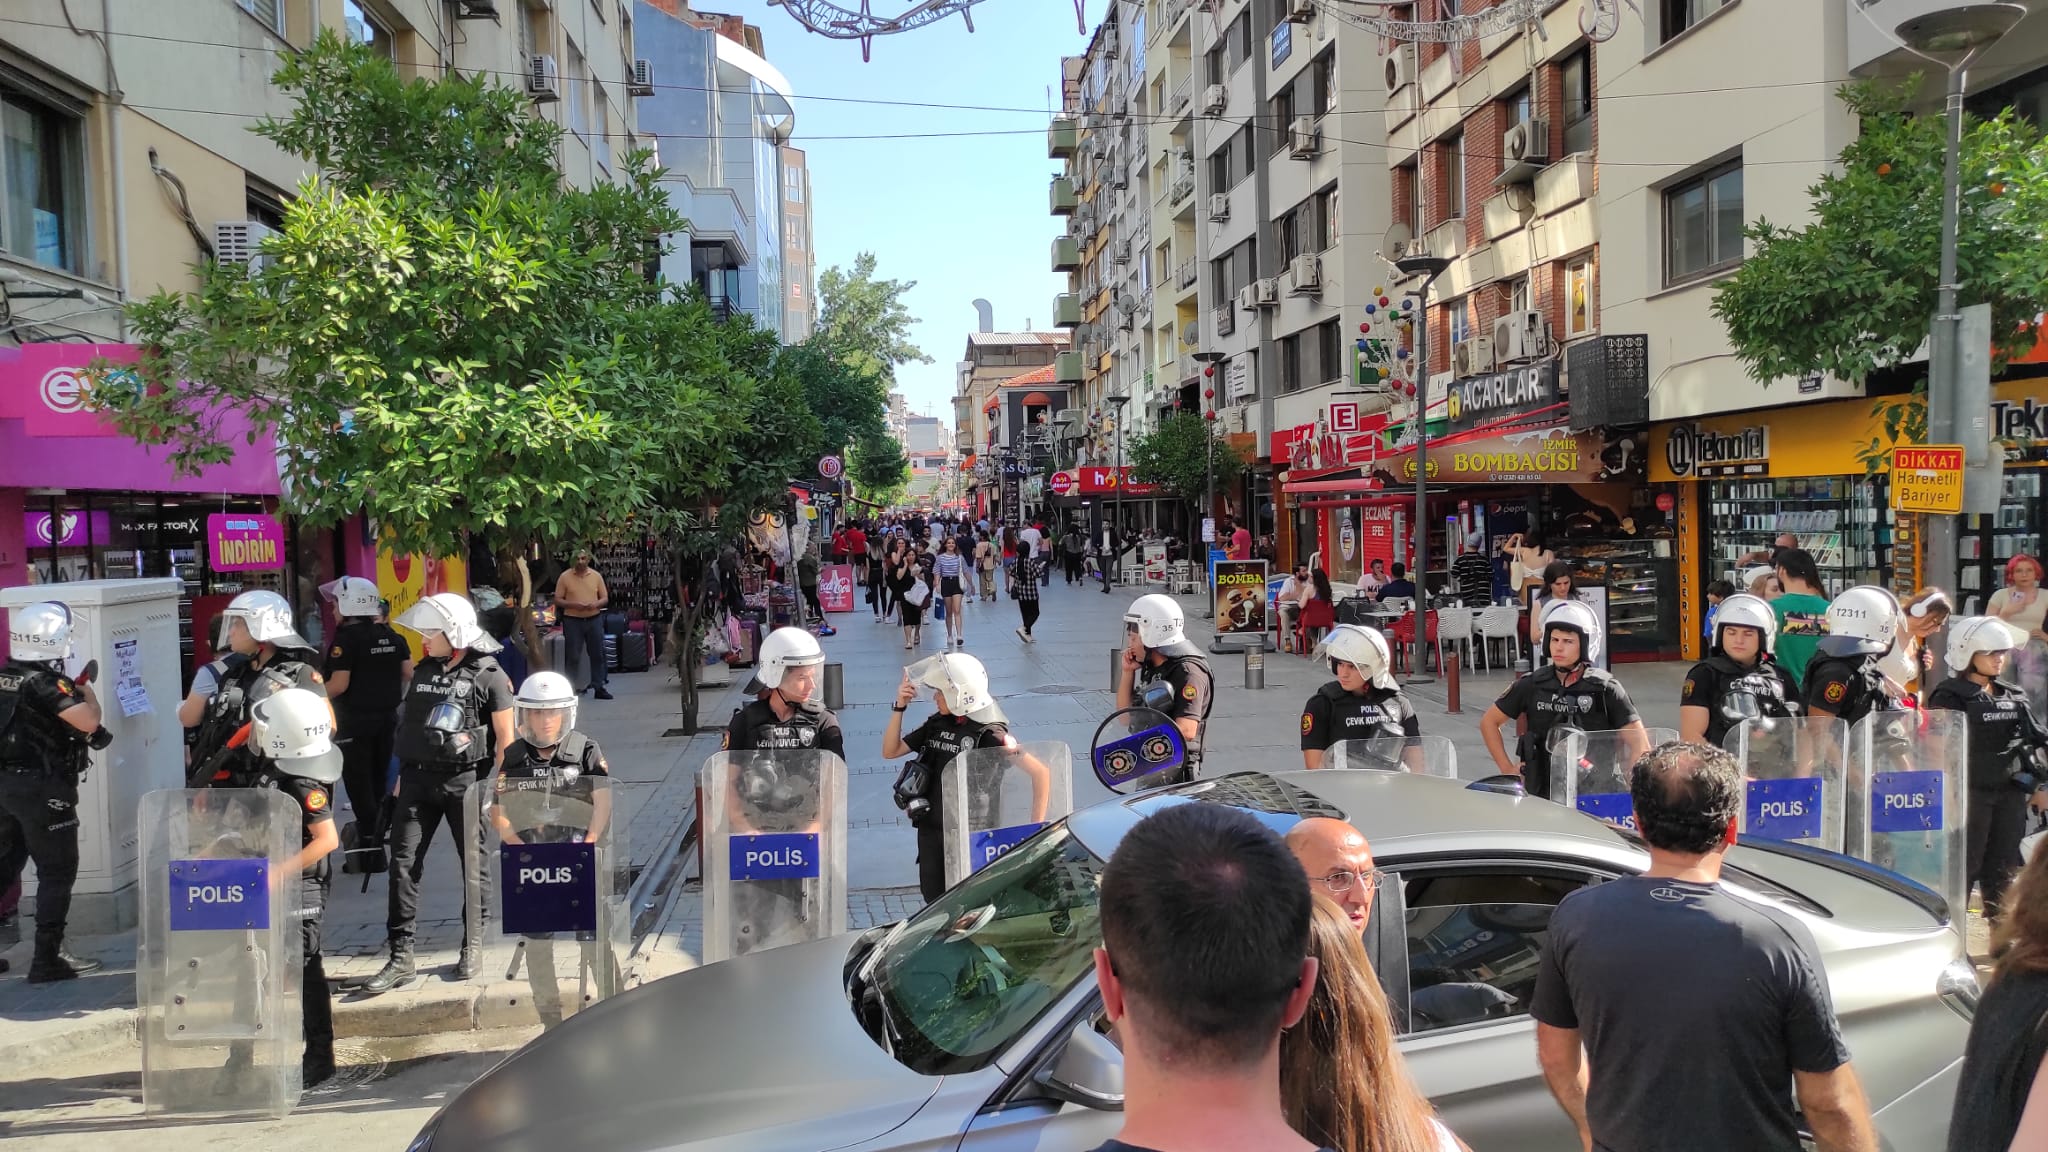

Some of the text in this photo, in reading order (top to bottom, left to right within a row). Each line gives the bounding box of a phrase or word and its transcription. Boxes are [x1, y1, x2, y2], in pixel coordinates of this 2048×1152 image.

[1463, 368, 1539, 412] ACARLAR
[1337, 407, 1353, 427] E
[1454, 453, 1578, 472] BOMBACISI
[1900, 452, 1957, 469] DİKKAT
[1897, 471, 1957, 486] Hareketli
[1901, 487, 1951, 505] Bariyer
[218, 531, 276, 565] İNDİRİM
[1217, 573, 1264, 585] BOMBA
[963, 696, 975, 705] 35
[272, 740, 286, 749] 35
